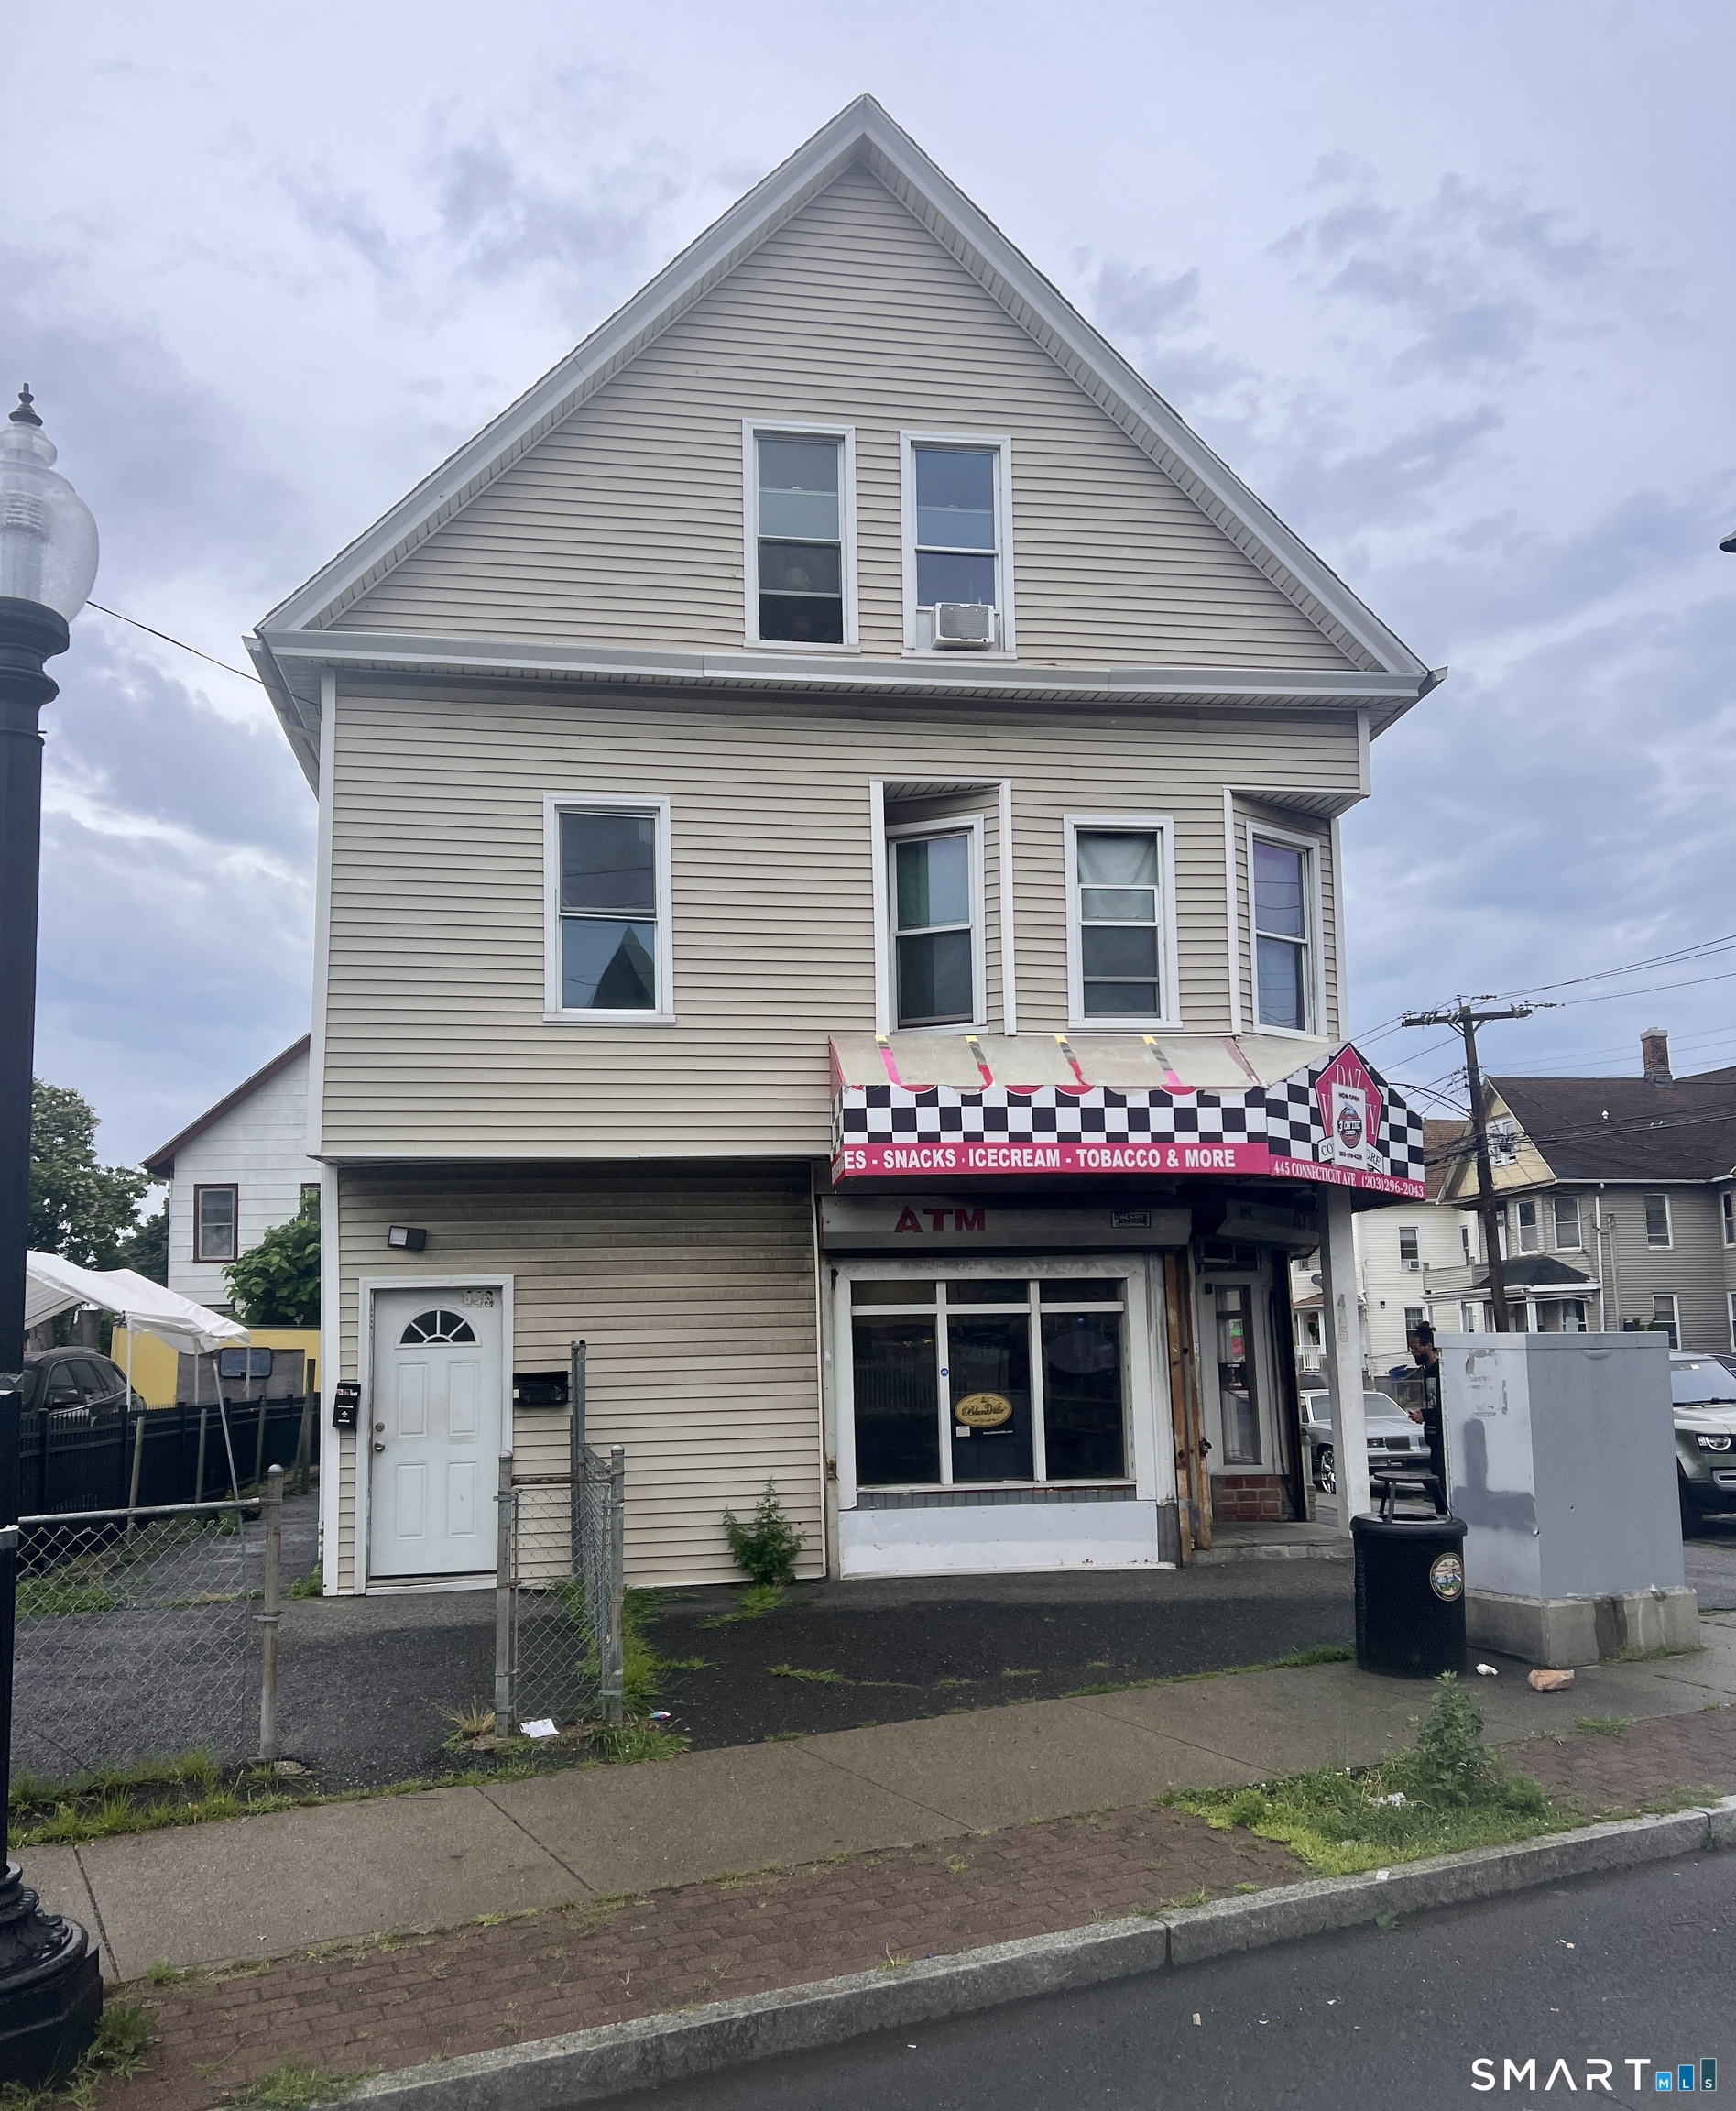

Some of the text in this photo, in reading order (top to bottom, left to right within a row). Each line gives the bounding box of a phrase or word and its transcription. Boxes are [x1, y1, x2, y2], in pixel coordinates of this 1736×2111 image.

[883, 1148, 956, 1169] SNACKS
[968, 1148, 1061, 1168] ICECREAM
[1076, 1148, 1161, 1168] TOBACCO
[1166, 1148, 1180, 1168] &
[1185, 1149, 1236, 1168] MORE
[1273, 1160, 1290, 1176] 445
[1291, 1162, 1342, 1185] CONNECTICUT
[1342, 1172, 1357, 1187] AVE
[894, 1209, 986, 1233] ATM
